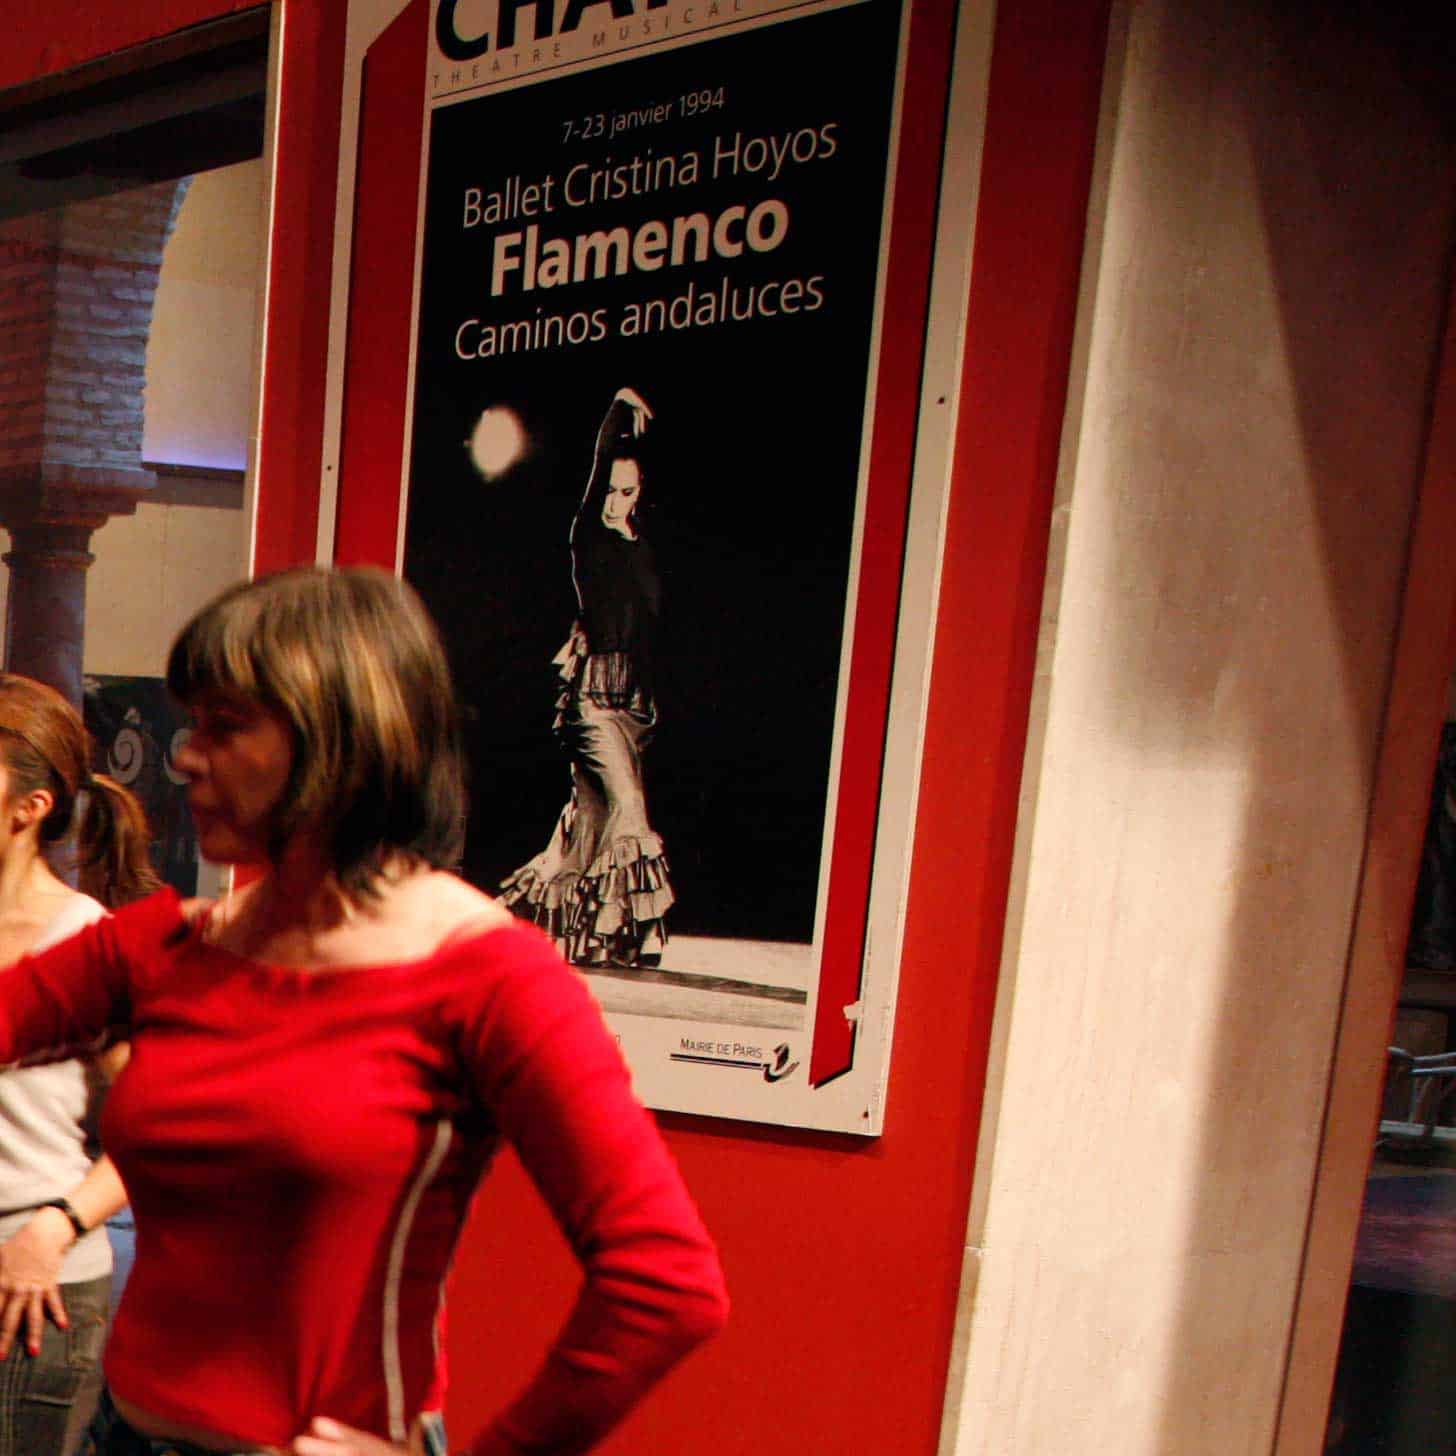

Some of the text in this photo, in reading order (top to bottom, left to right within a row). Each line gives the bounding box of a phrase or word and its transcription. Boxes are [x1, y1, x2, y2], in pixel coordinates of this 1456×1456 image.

[432, 0, 742, 86] THEATRE MUSICAL
[562, 86, 725, 143] 7-23 janvier 1994
[462, 123, 837, 229] Ballet Cristina Hoyos
[490, 199, 789, 297] Flamenco
[454, 276, 824, 361] Caminos andaluces
